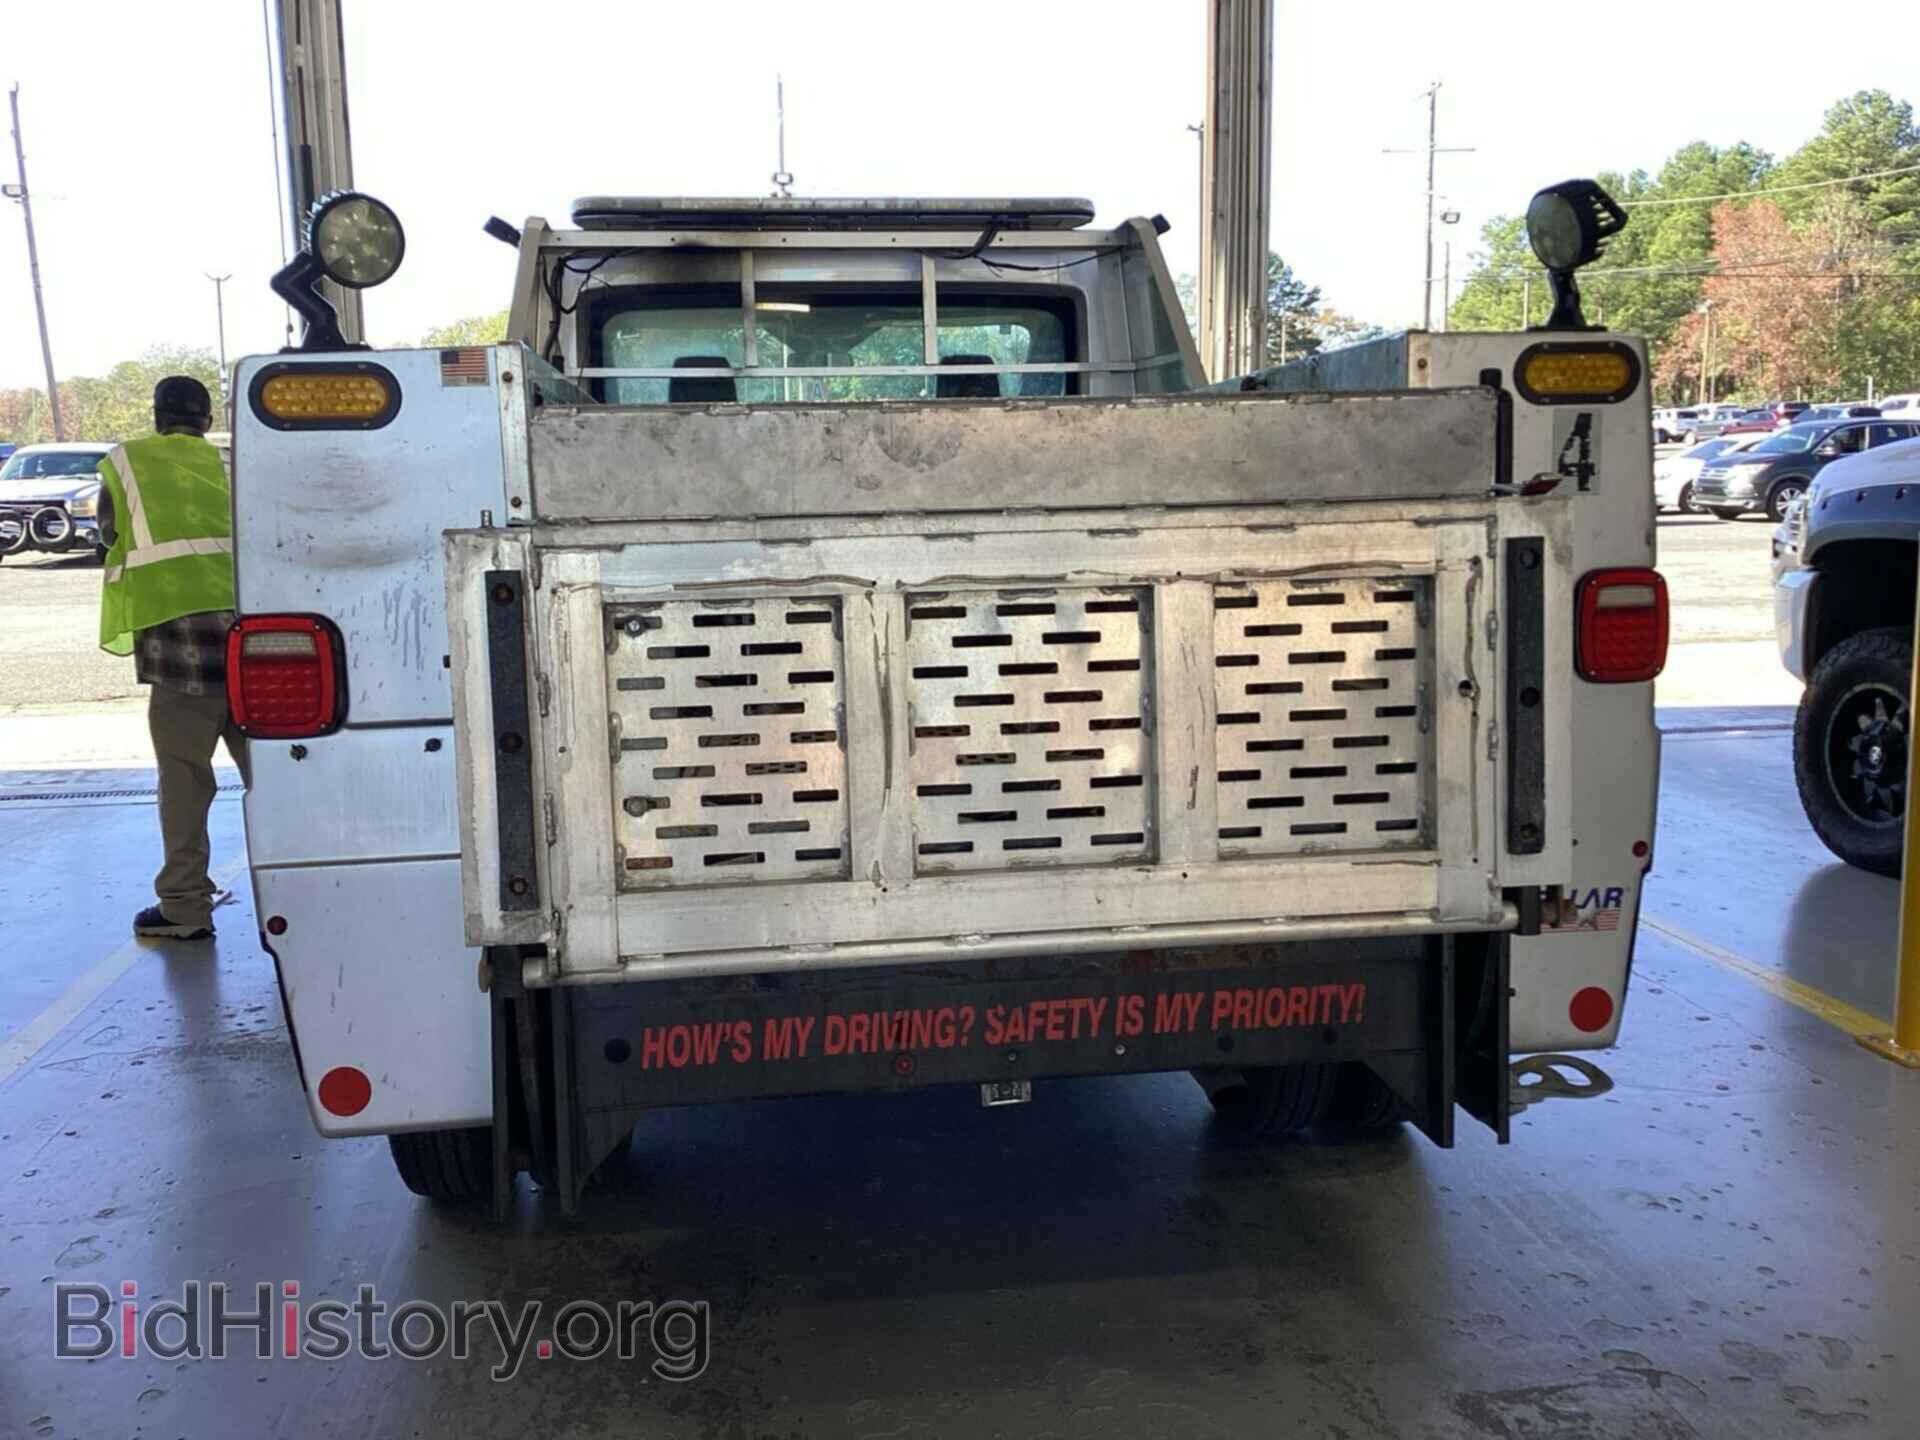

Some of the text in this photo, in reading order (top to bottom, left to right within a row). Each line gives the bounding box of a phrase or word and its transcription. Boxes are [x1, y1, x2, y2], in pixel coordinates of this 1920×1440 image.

[1558, 412, 1595, 492] 4
[641, 983, 1367, 1071] HOW'S MY DRIVING? SAFETY IS MY PRIORITY!
